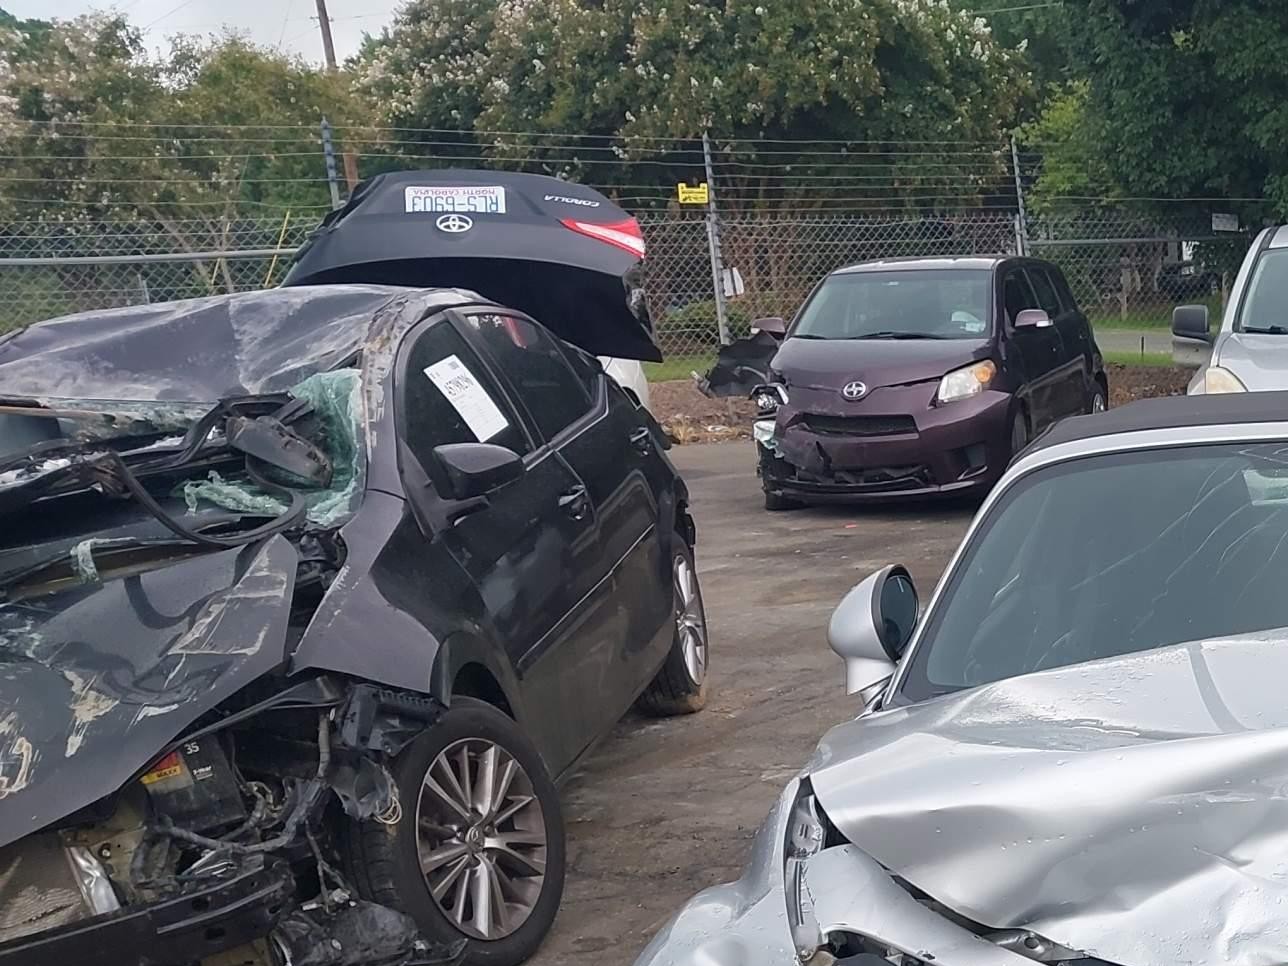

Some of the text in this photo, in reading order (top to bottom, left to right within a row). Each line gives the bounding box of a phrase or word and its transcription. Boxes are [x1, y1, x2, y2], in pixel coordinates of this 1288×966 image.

[413, 188, 459, 196] CAROLINA
[544, 195, 600, 207] COROLLA
[184, 741, 200, 755] 35
